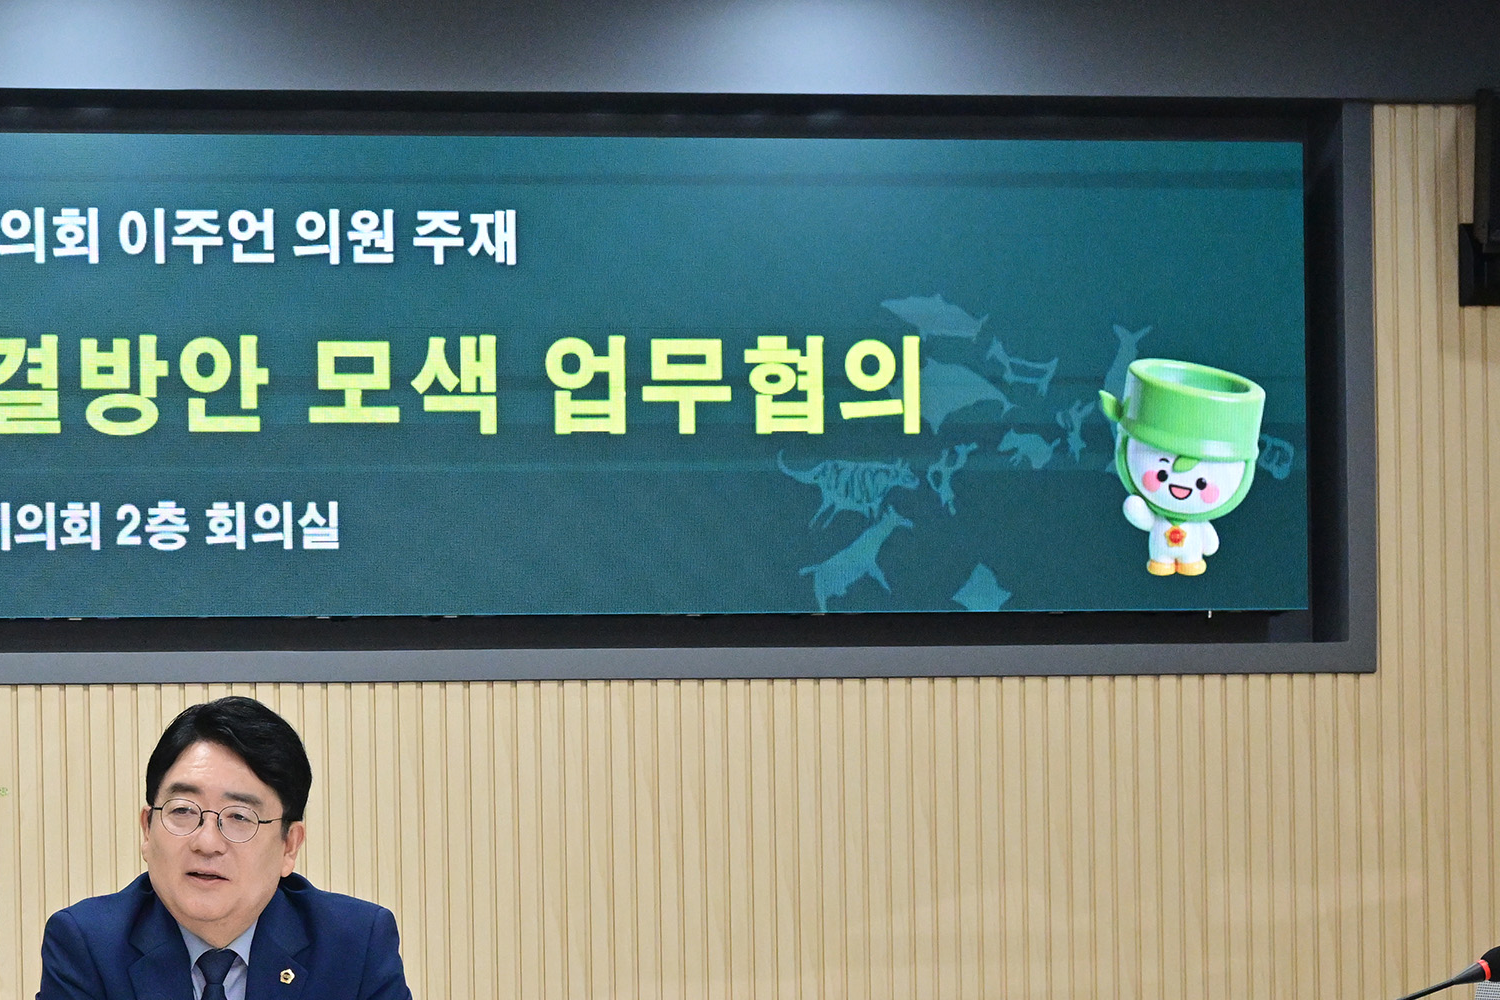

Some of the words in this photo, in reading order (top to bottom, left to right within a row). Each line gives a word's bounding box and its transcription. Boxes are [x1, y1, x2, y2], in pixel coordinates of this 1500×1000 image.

[119, 208, 276, 265] 이주언
[294, 209, 396, 266] 의원
[413, 210, 518, 266] 주재
[307, 334, 498, 436] 모색
[544, 335, 922, 436] 업무협의
[116, 502, 191, 552] 2층
[205, 501, 340, 552] 회의실
